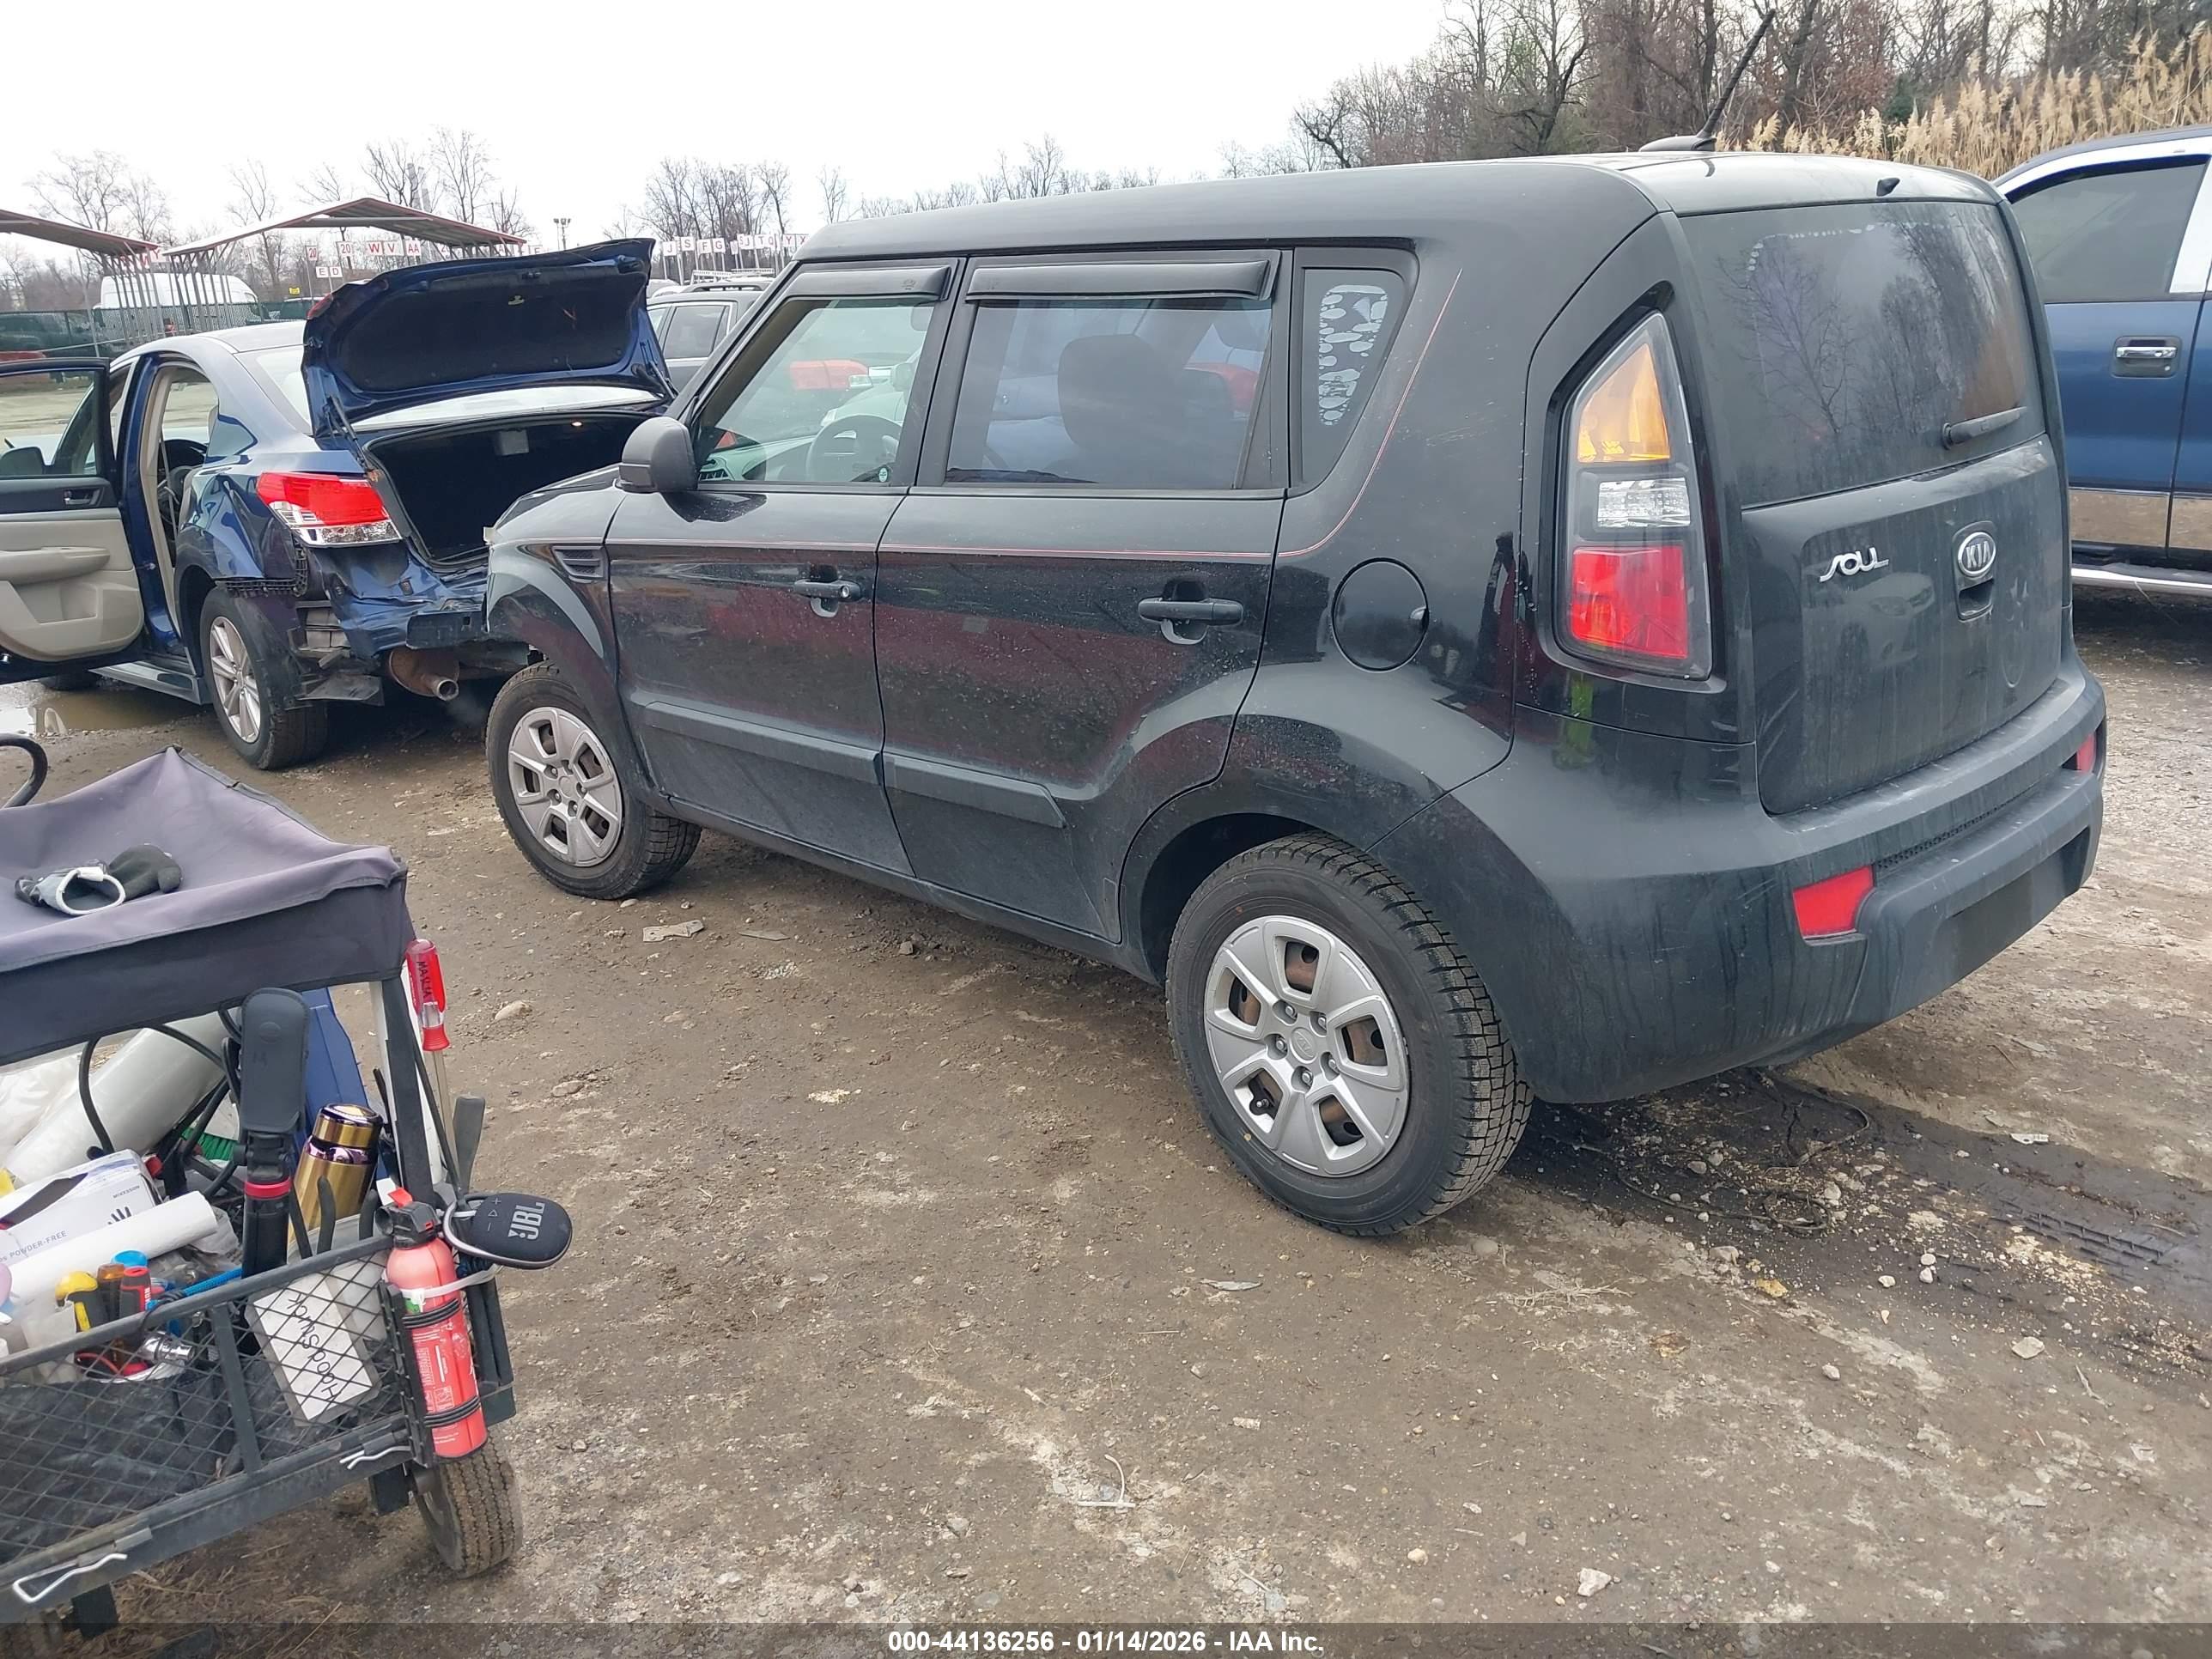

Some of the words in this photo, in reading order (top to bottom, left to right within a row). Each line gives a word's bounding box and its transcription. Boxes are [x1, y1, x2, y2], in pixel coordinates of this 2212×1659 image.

[684, 239, 691, 248] S
[715, 240, 723, 250] G
[786, 236, 792, 245] Y
[308, 247, 317, 258] 20
[340, 244, 351, 254] 20
[368, 243, 380, 252] W
[387, 243, 395, 252] V
[408, 244, 420, 253] AA
[1965, 540, 1991, 569] KIA
[1819, 546, 1889, 583] SOUL
[508, 1201, 545, 1240] JBL
[9, 1230, 68, 1258] POWDER-FREE
[307, 1348, 343, 1401] Hood
